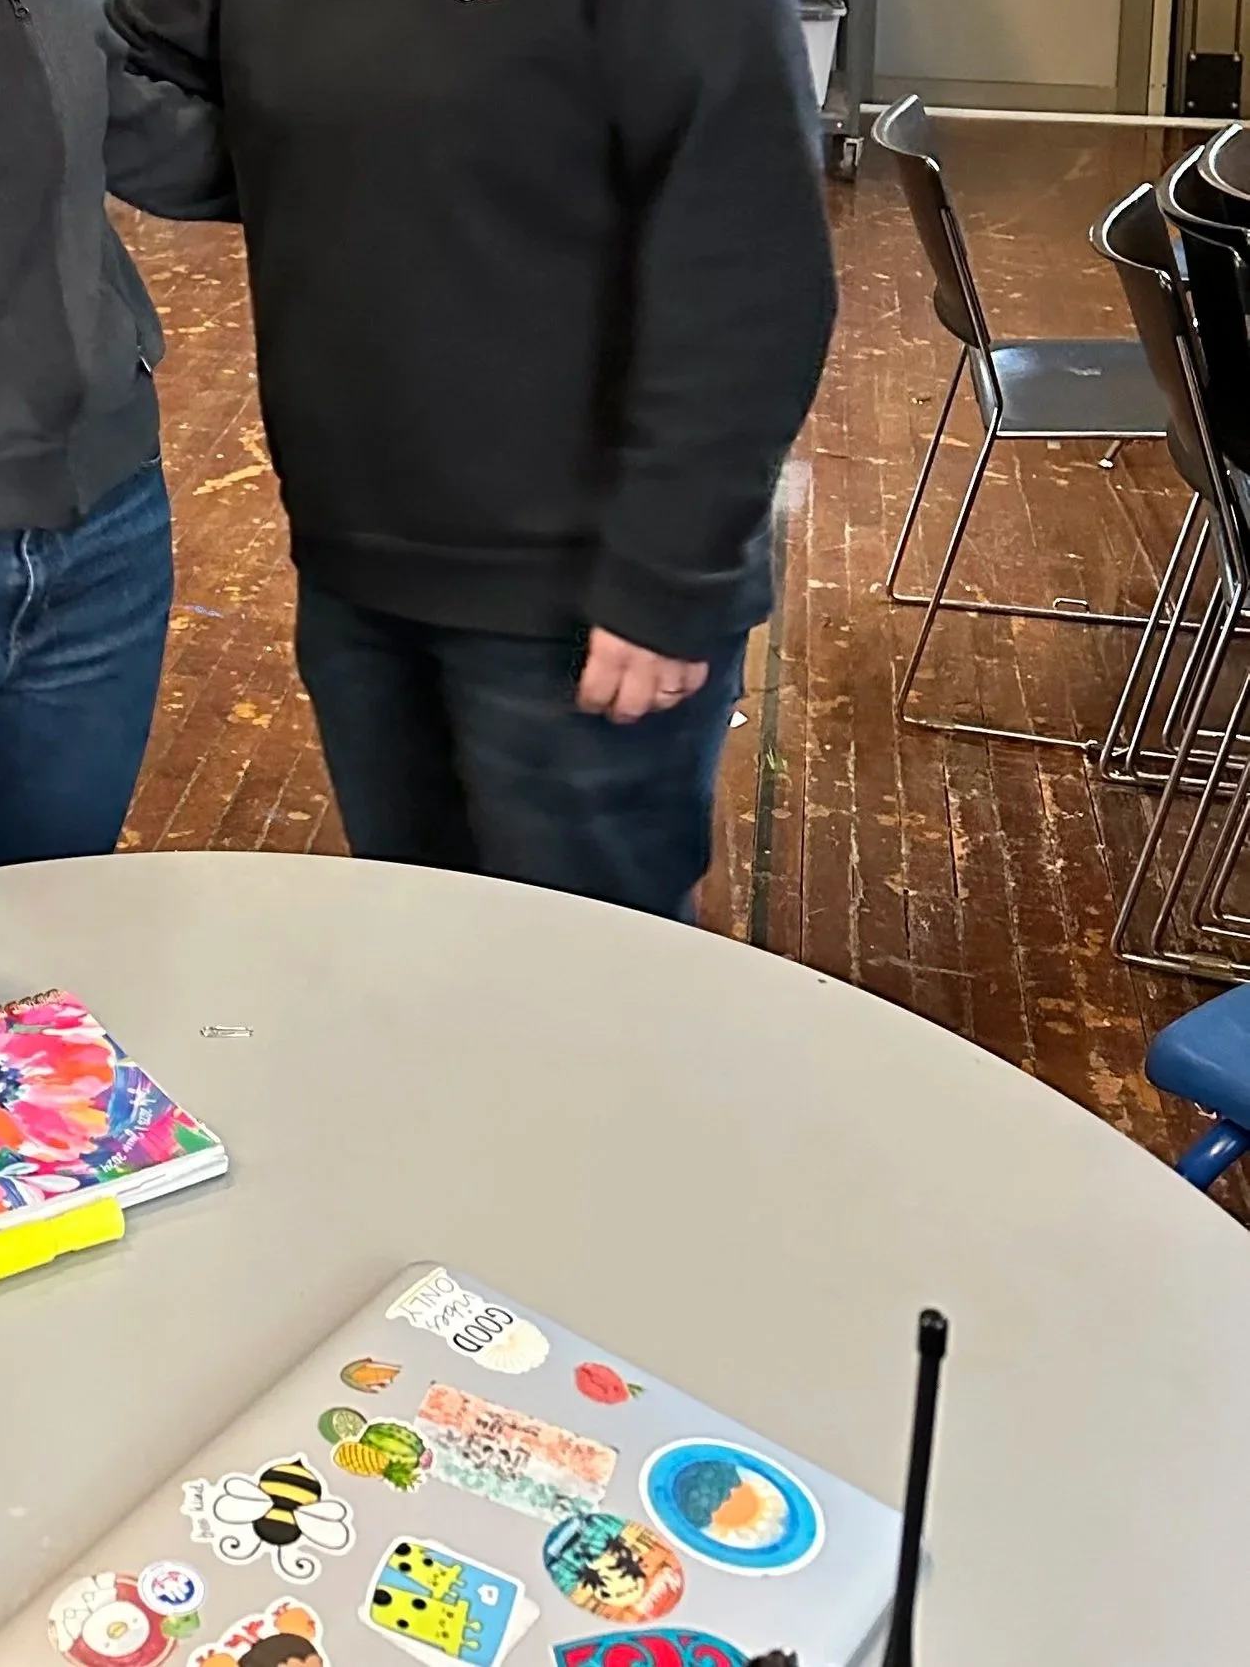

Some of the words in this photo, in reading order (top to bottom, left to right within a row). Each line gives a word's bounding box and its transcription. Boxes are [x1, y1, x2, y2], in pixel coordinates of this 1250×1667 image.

[400, 1277, 454, 1323] ONLY
[426, 1294, 476, 1331] vibes
[453, 1307, 514, 1353] GOOD
